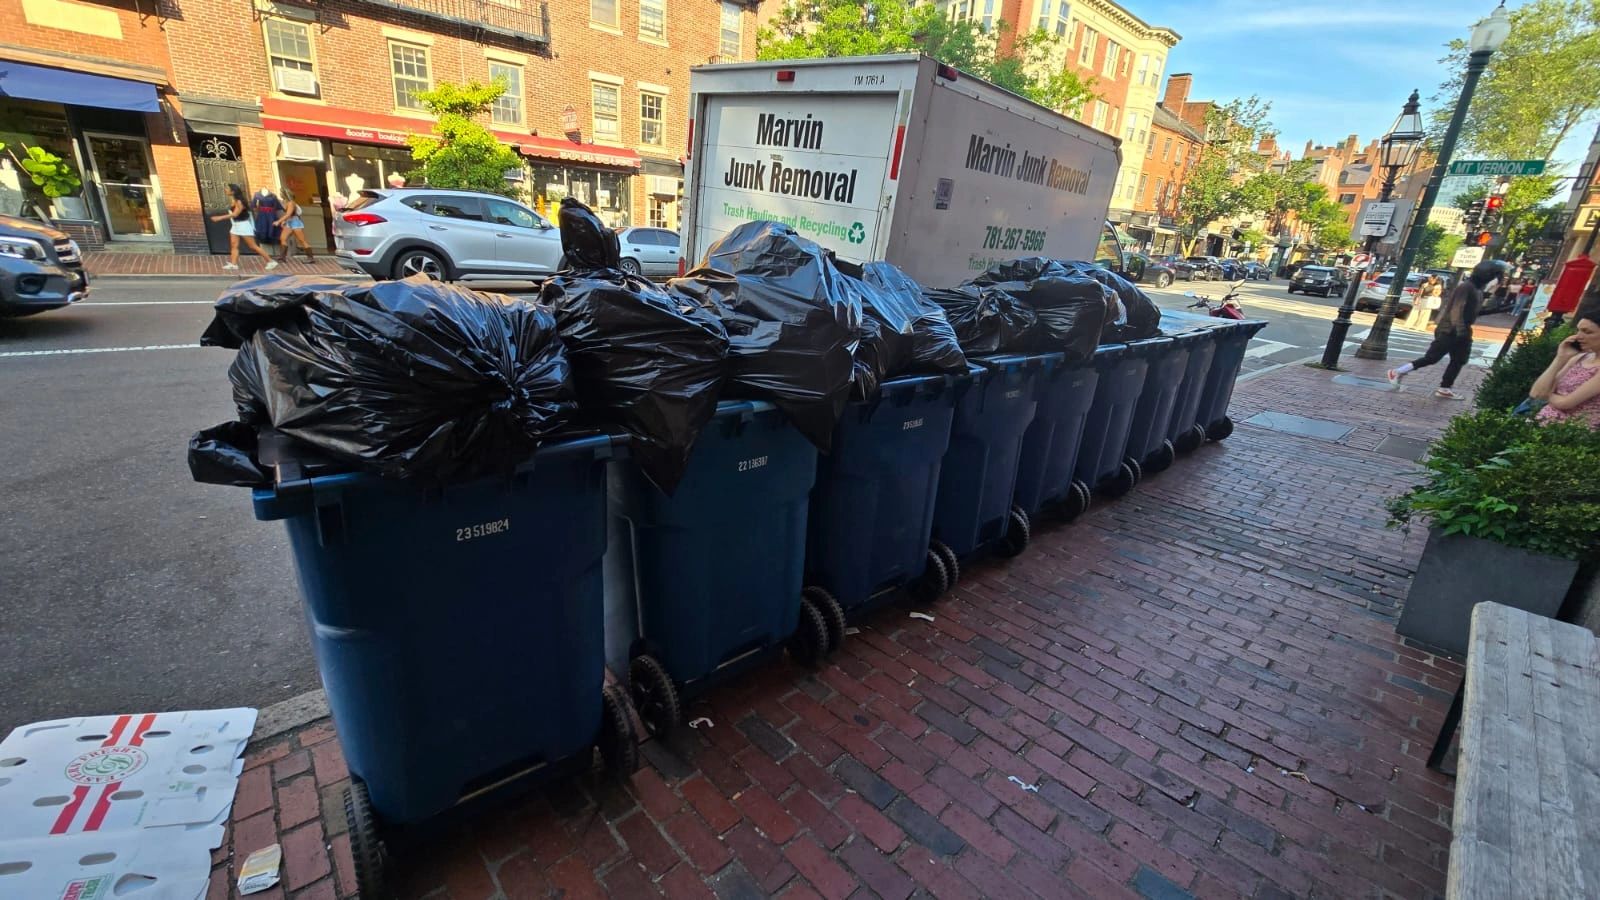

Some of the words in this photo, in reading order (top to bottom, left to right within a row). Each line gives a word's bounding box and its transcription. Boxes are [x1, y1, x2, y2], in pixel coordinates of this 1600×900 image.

[865, 75, 880, 85] 1761
[880, 75, 886, 85] A
[756, 113, 824, 150] Marvin
[724, 157, 766, 191] Junk
[769, 161, 858, 204] Removal
[965, 133, 1017, 178] Marvin
[1016, 150, 1048, 186] Junk
[1046, 158, 1092, 196] Removal
[1455, 162, 1474, 174] MT
[1476, 162, 1526, 174] VERNON
[723, 202, 745, 218] Trash
[746, 207, 778, 222] Hauling
[780, 216, 798, 228] and
[799, 216, 848, 241] Recycling
[983, 225, 1046, 252] 781-267-5966
[79, 747, 131, 763] FRESH
